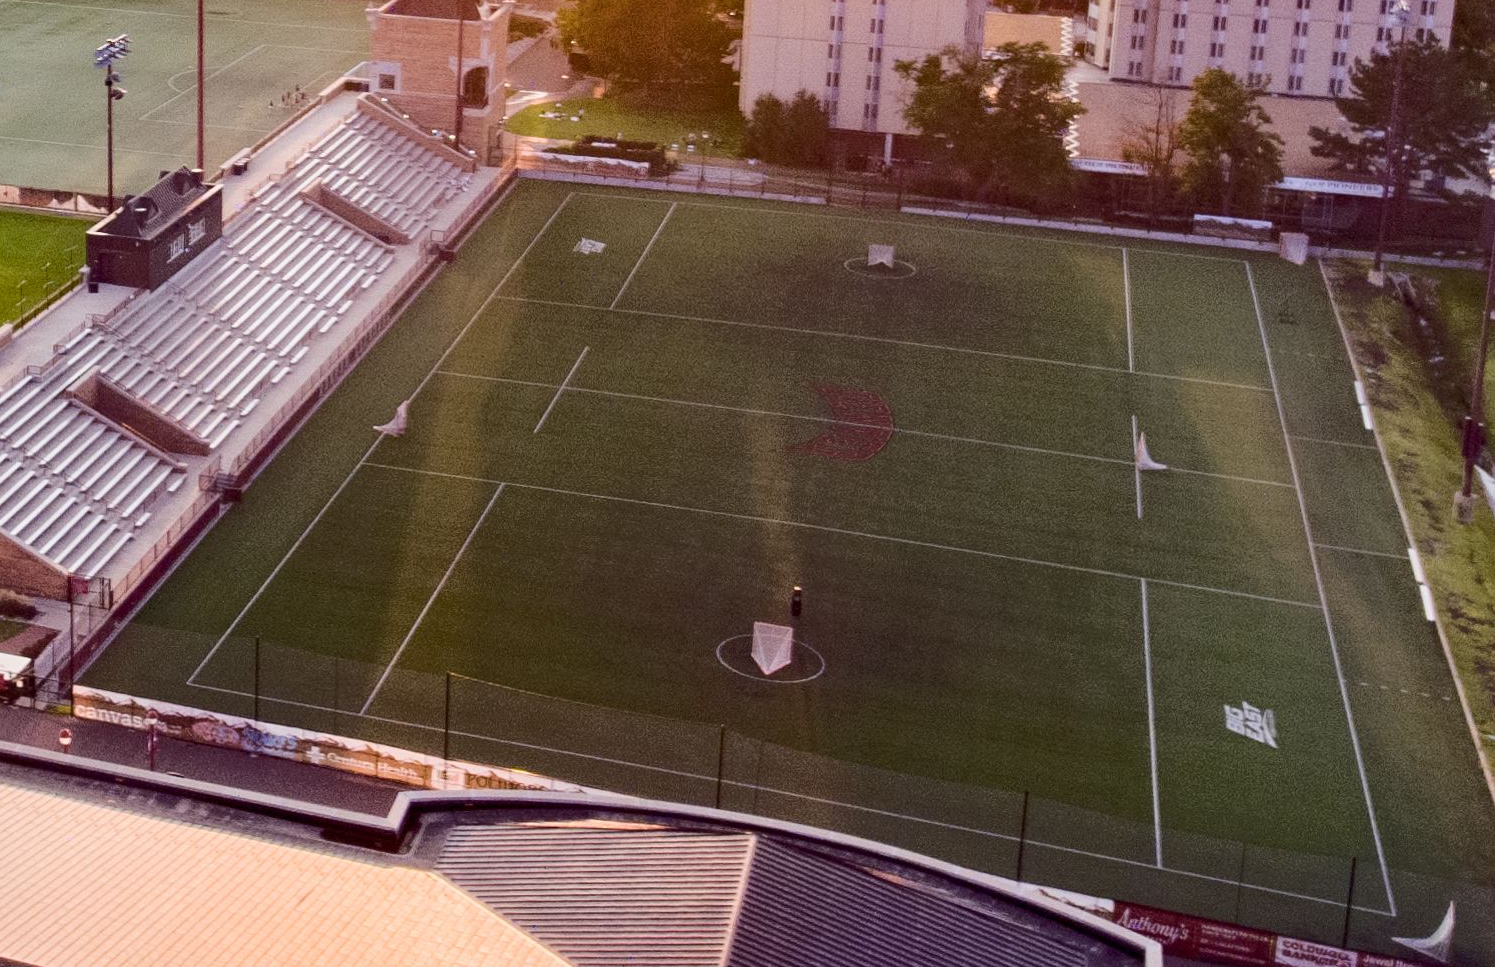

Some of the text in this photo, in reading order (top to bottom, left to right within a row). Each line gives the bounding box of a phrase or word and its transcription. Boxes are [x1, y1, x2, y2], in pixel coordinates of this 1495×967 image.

[74, 703, 144, 730] canvas
[1117, 907, 1190, 943] Anthony's
[1282, 939, 1352, 961] COLDWELL
